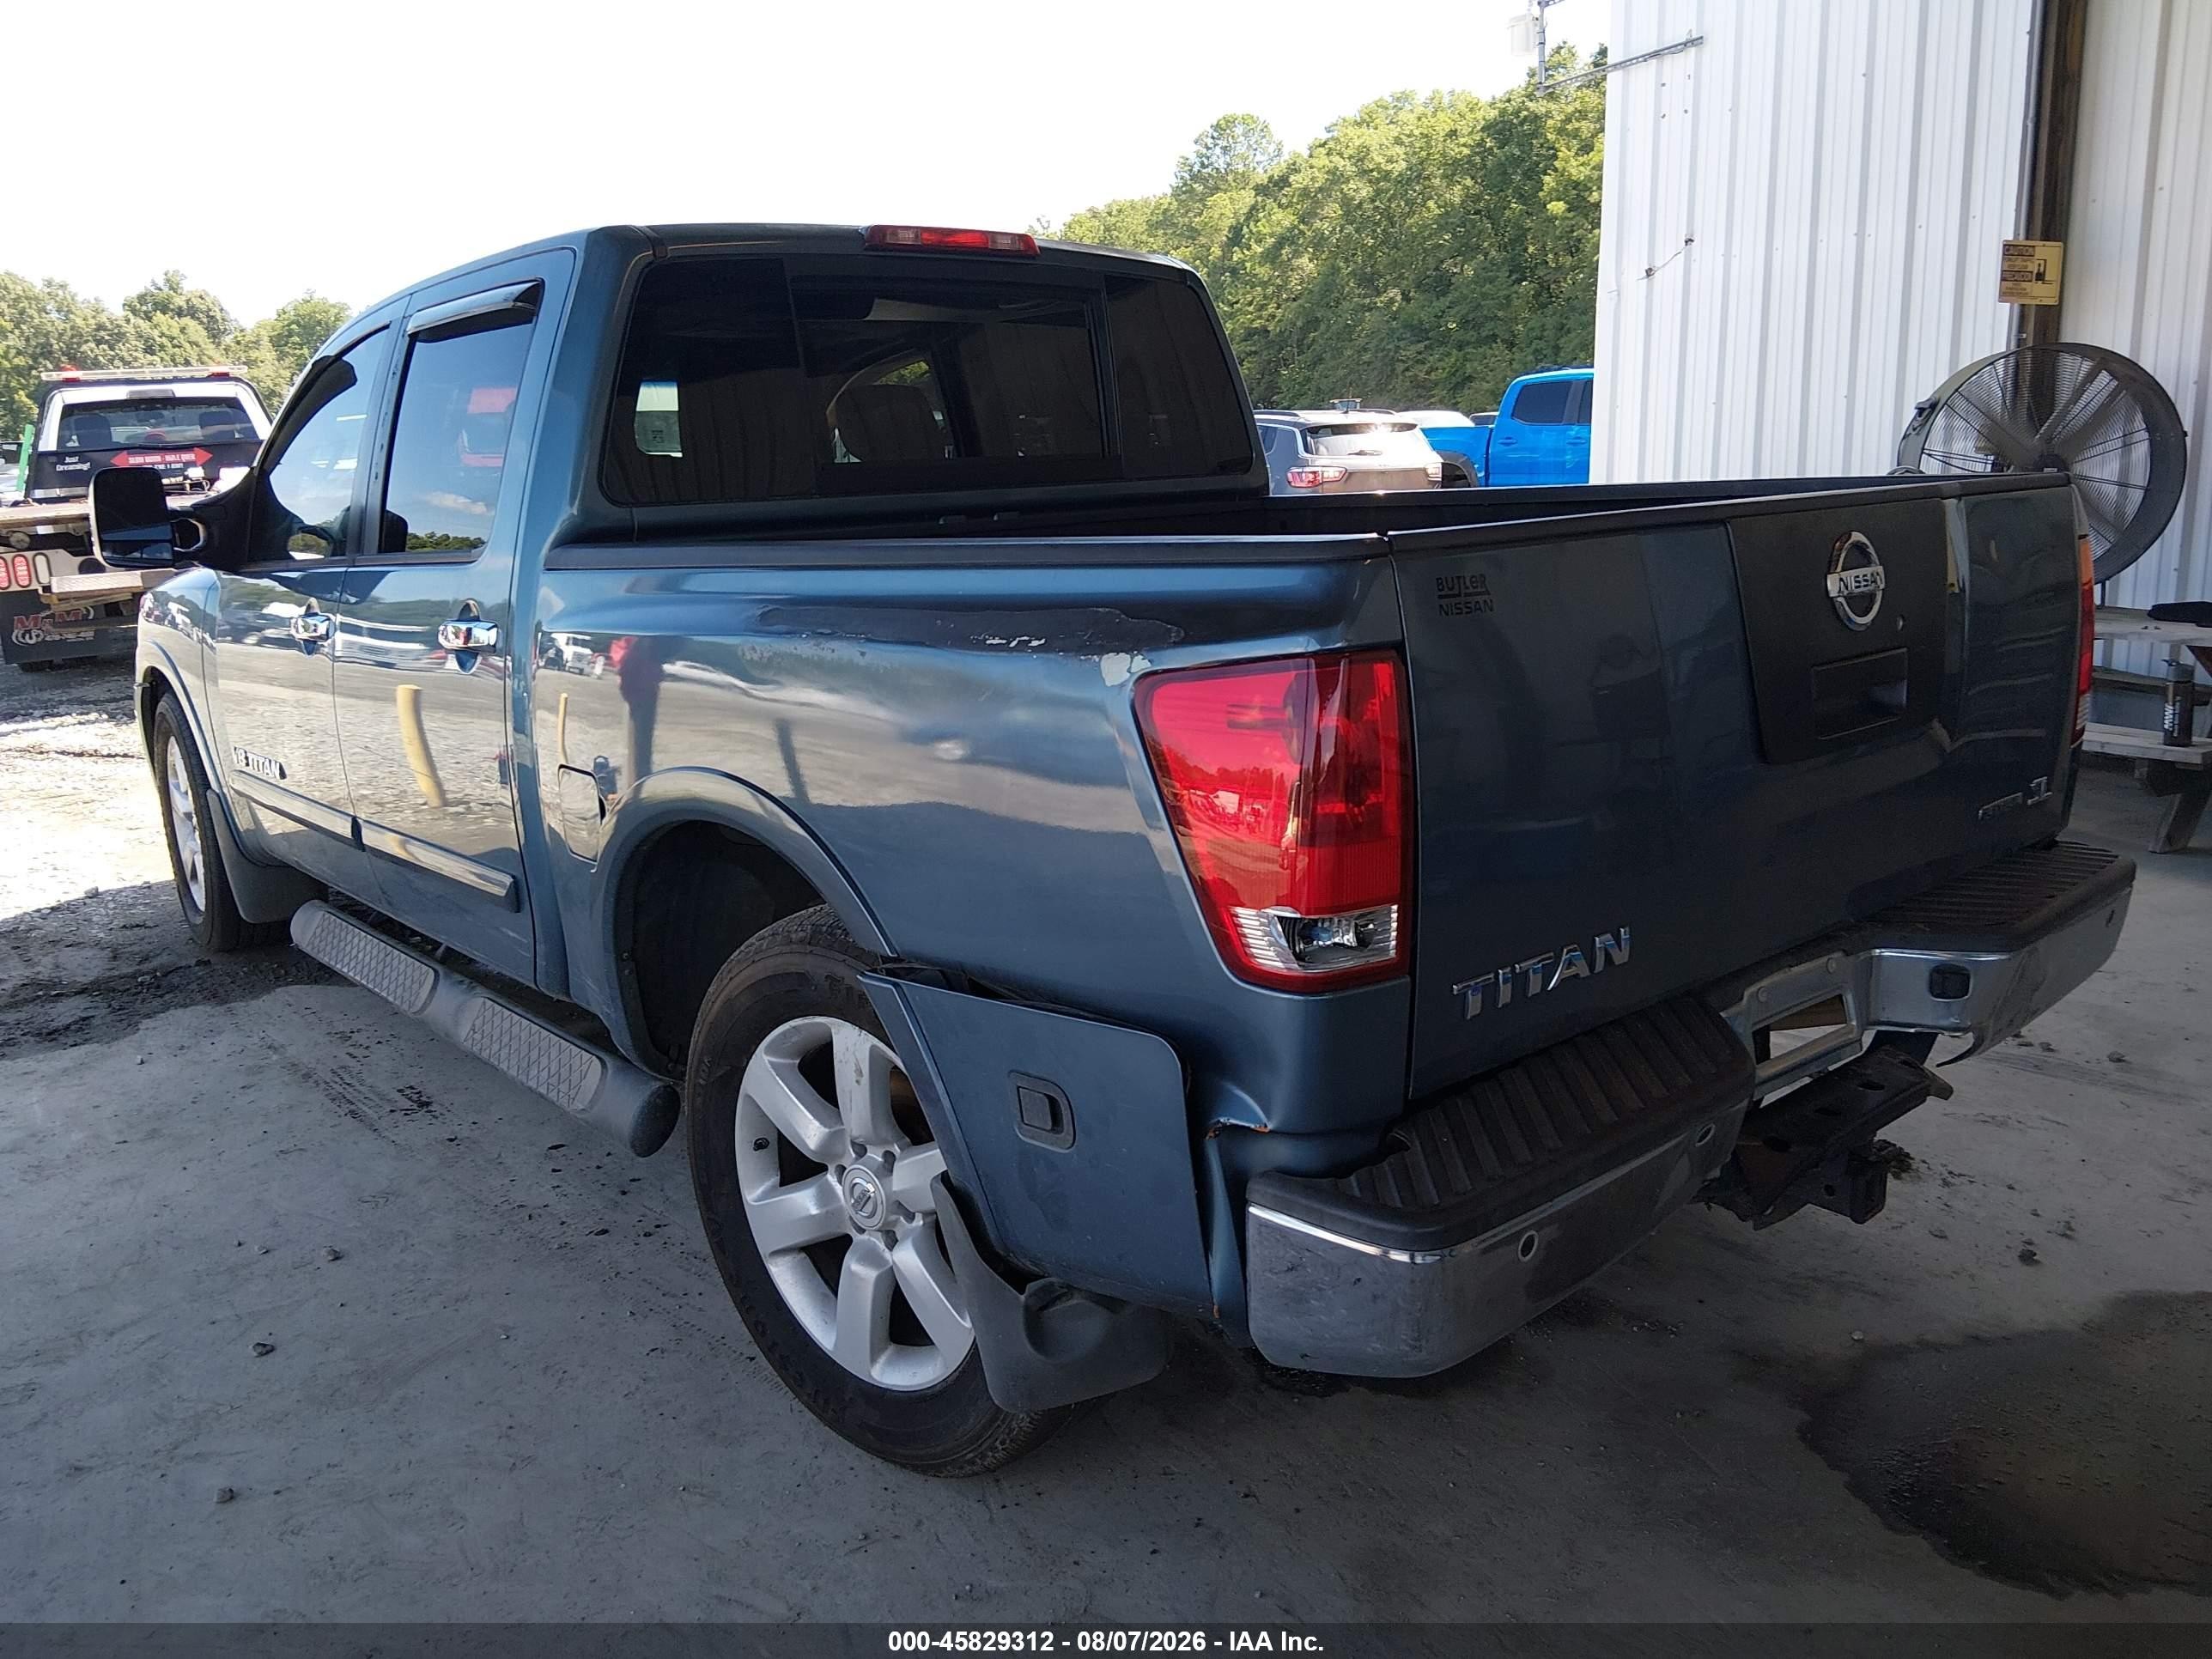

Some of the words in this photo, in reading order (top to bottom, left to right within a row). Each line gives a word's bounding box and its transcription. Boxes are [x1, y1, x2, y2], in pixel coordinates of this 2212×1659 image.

[1438, 599, 1494, 617] NISSAN
[247, 752, 282, 781] TITAN
[1452, 927, 1632, 1020] TITAN
